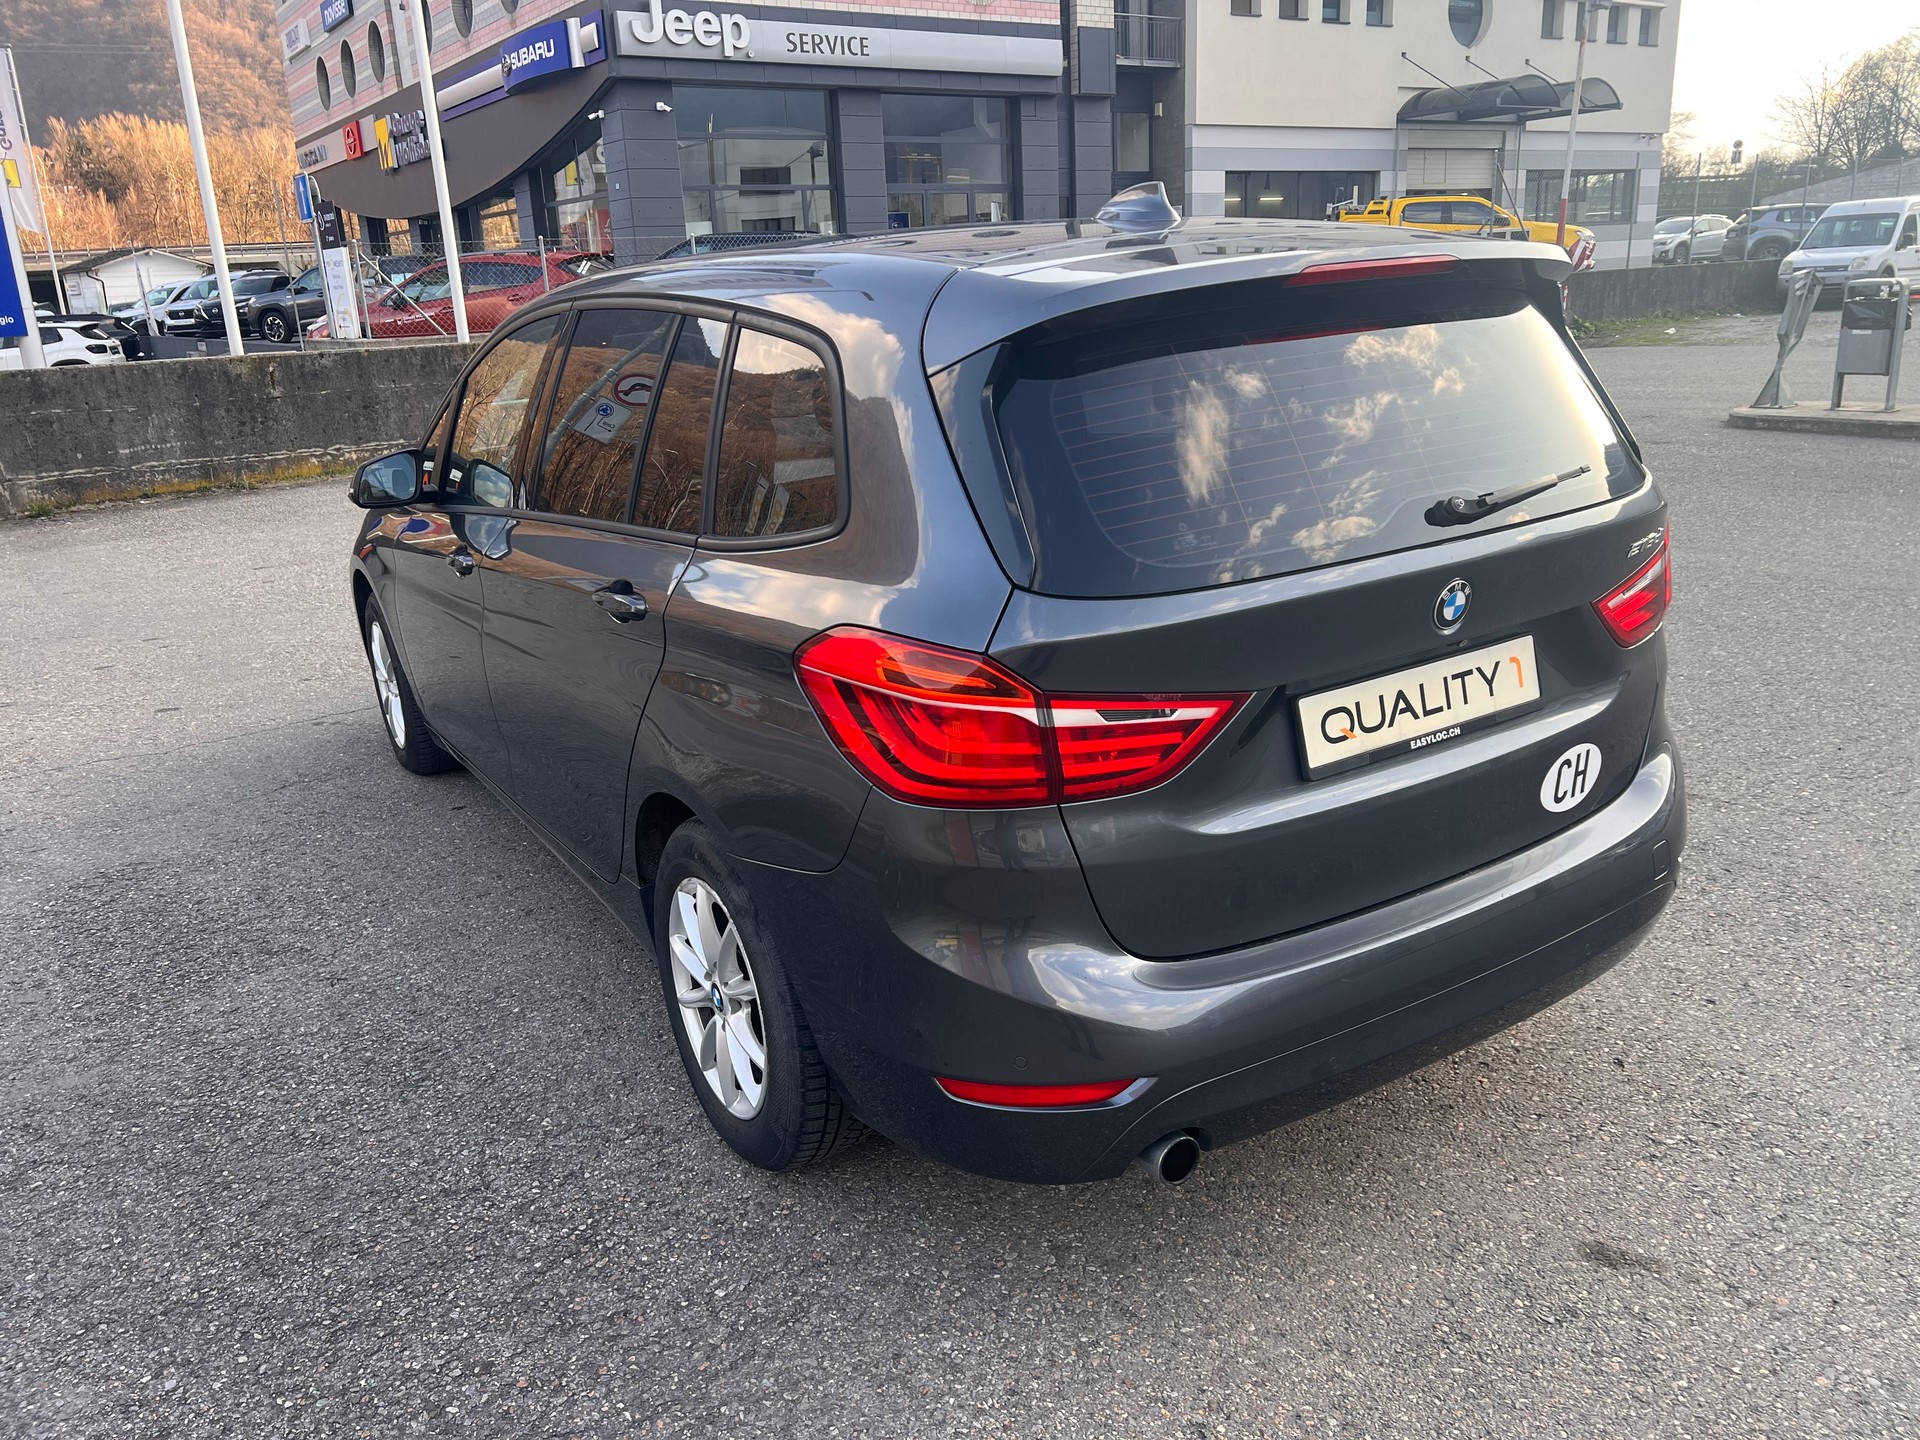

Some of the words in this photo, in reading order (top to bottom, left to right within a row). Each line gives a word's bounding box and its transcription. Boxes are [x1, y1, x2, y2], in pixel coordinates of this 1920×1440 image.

[630, 0, 751, 57] Jeep
[785, 32, 870, 57] SERVICE
[510, 38, 555, 70] SUBARU
[1442, 582, 1471, 601] BMW
[1320, 660, 1501, 745] QUALITY
[1508, 656, 1524, 689] 1
[1410, 726, 1461, 750] EASYLOC.CH
[1553, 748, 1591, 805] CH
